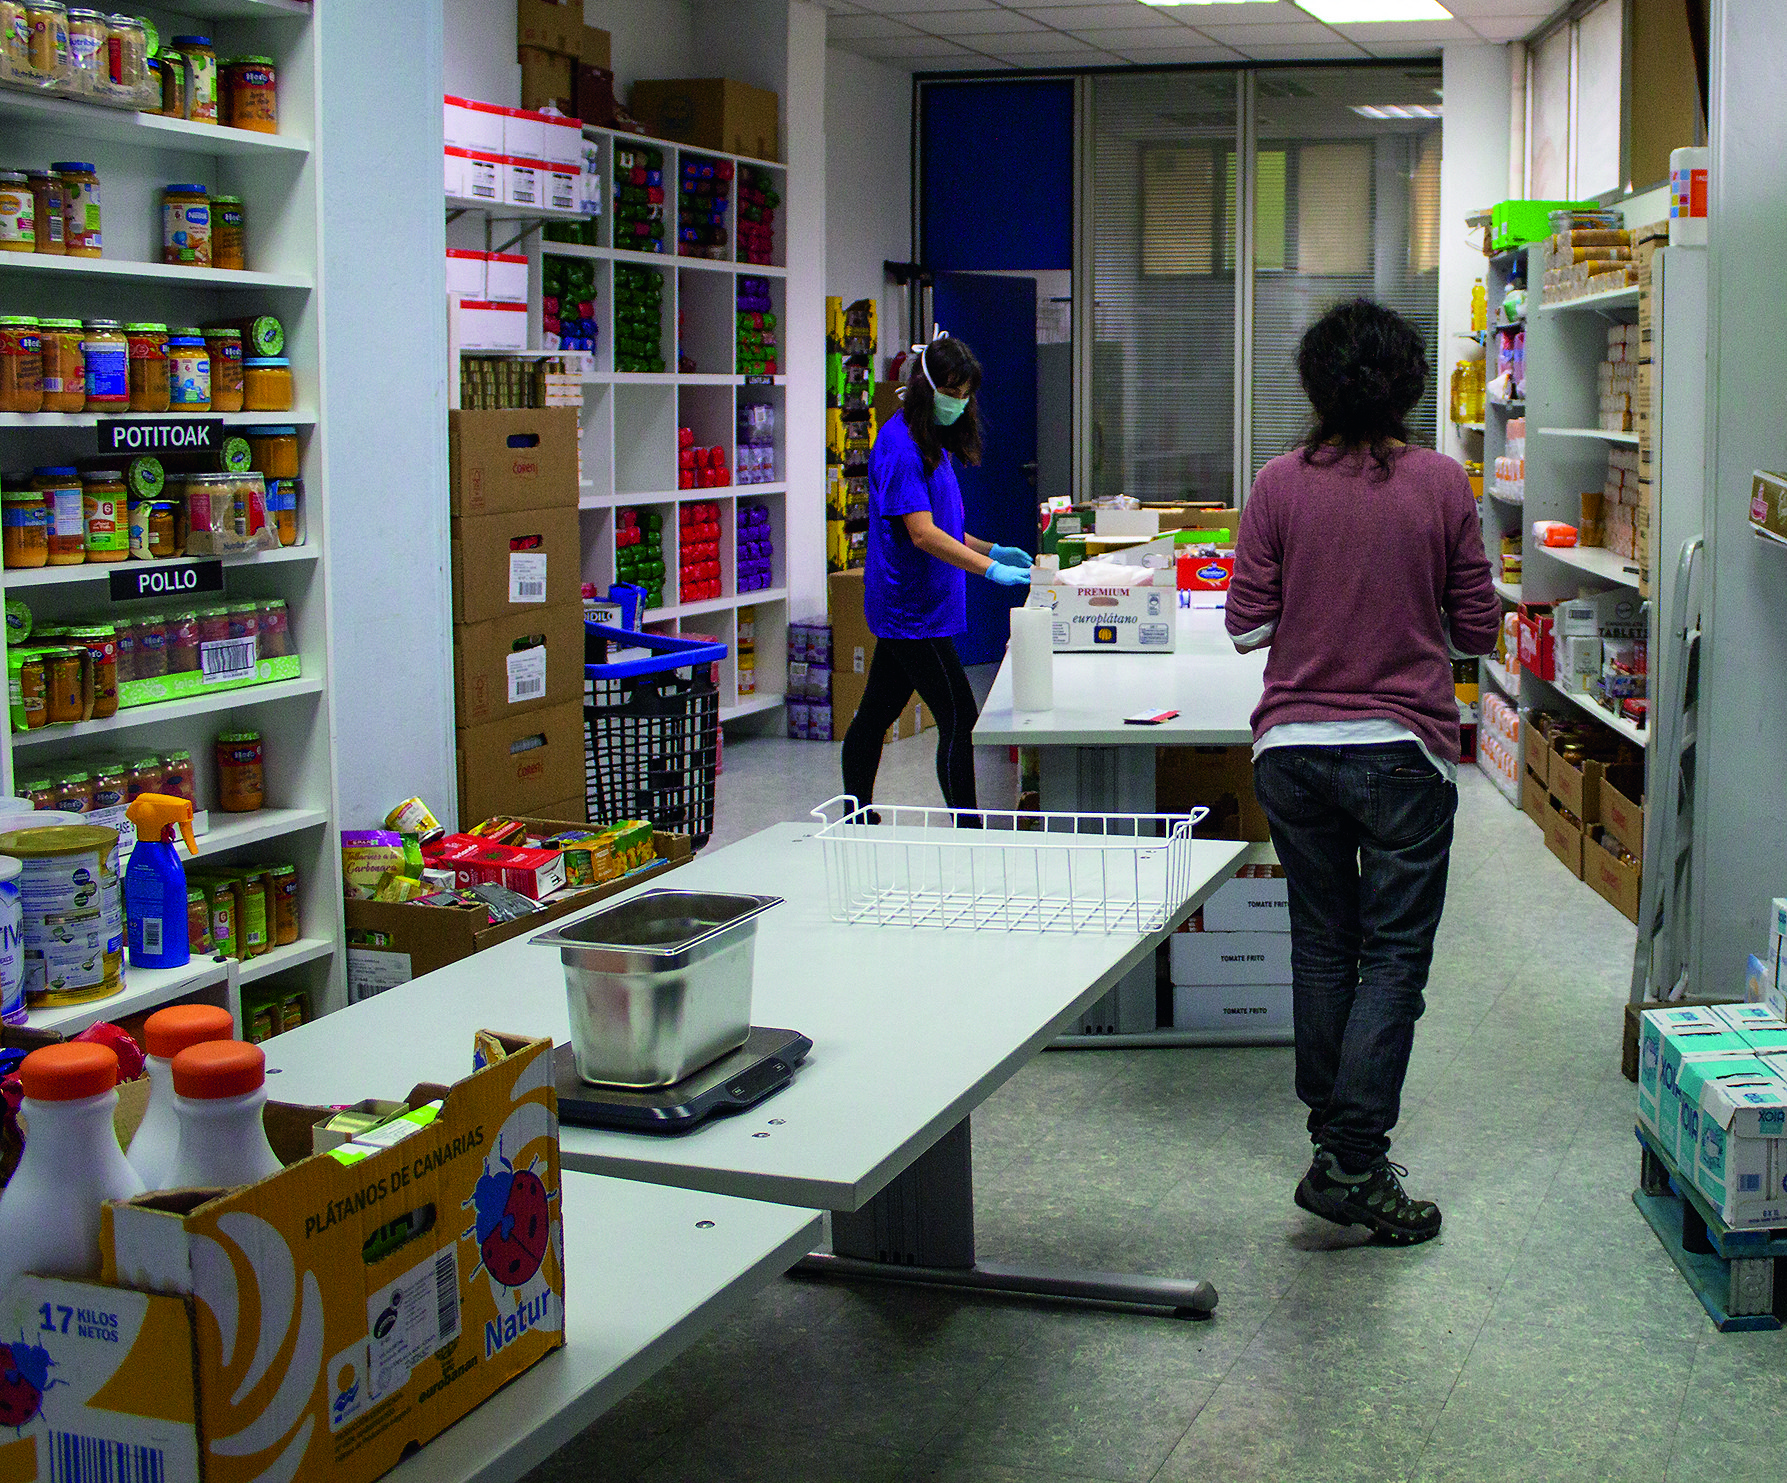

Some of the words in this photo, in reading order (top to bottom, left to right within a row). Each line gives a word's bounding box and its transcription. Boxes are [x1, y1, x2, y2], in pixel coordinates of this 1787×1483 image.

[245, 72, 267, 80] Hero
[112, 425, 210, 448] POTITOAK
[104, 504, 113, 514] 6
[138, 569, 198, 594] POLLO
[1077, 587, 1130, 597] PREMIUM
[1072, 612, 1139, 627] europlátano
[390, 852, 398, 860] la
[346, 862, 398, 875] Carbonara
[1246, 954, 1265, 962] FRITO
[1223, 1007, 1248, 1015] TOMATE
[1249, 1007, 1268, 1015] FRITO
[304, 1178, 388, 1240] PLÁTANOS
[390, 1165, 411, 1194] DE
[412, 1125, 485, 1180] CANARIAS
[38, 1301, 74, 1335] 17
[77, 1307, 119, 1328] KILOS
[484, 1286, 552, 1359] Natur
[77, 1324, 119, 1343] NETOS
[417, 1355, 479, 1404] eurobanan
